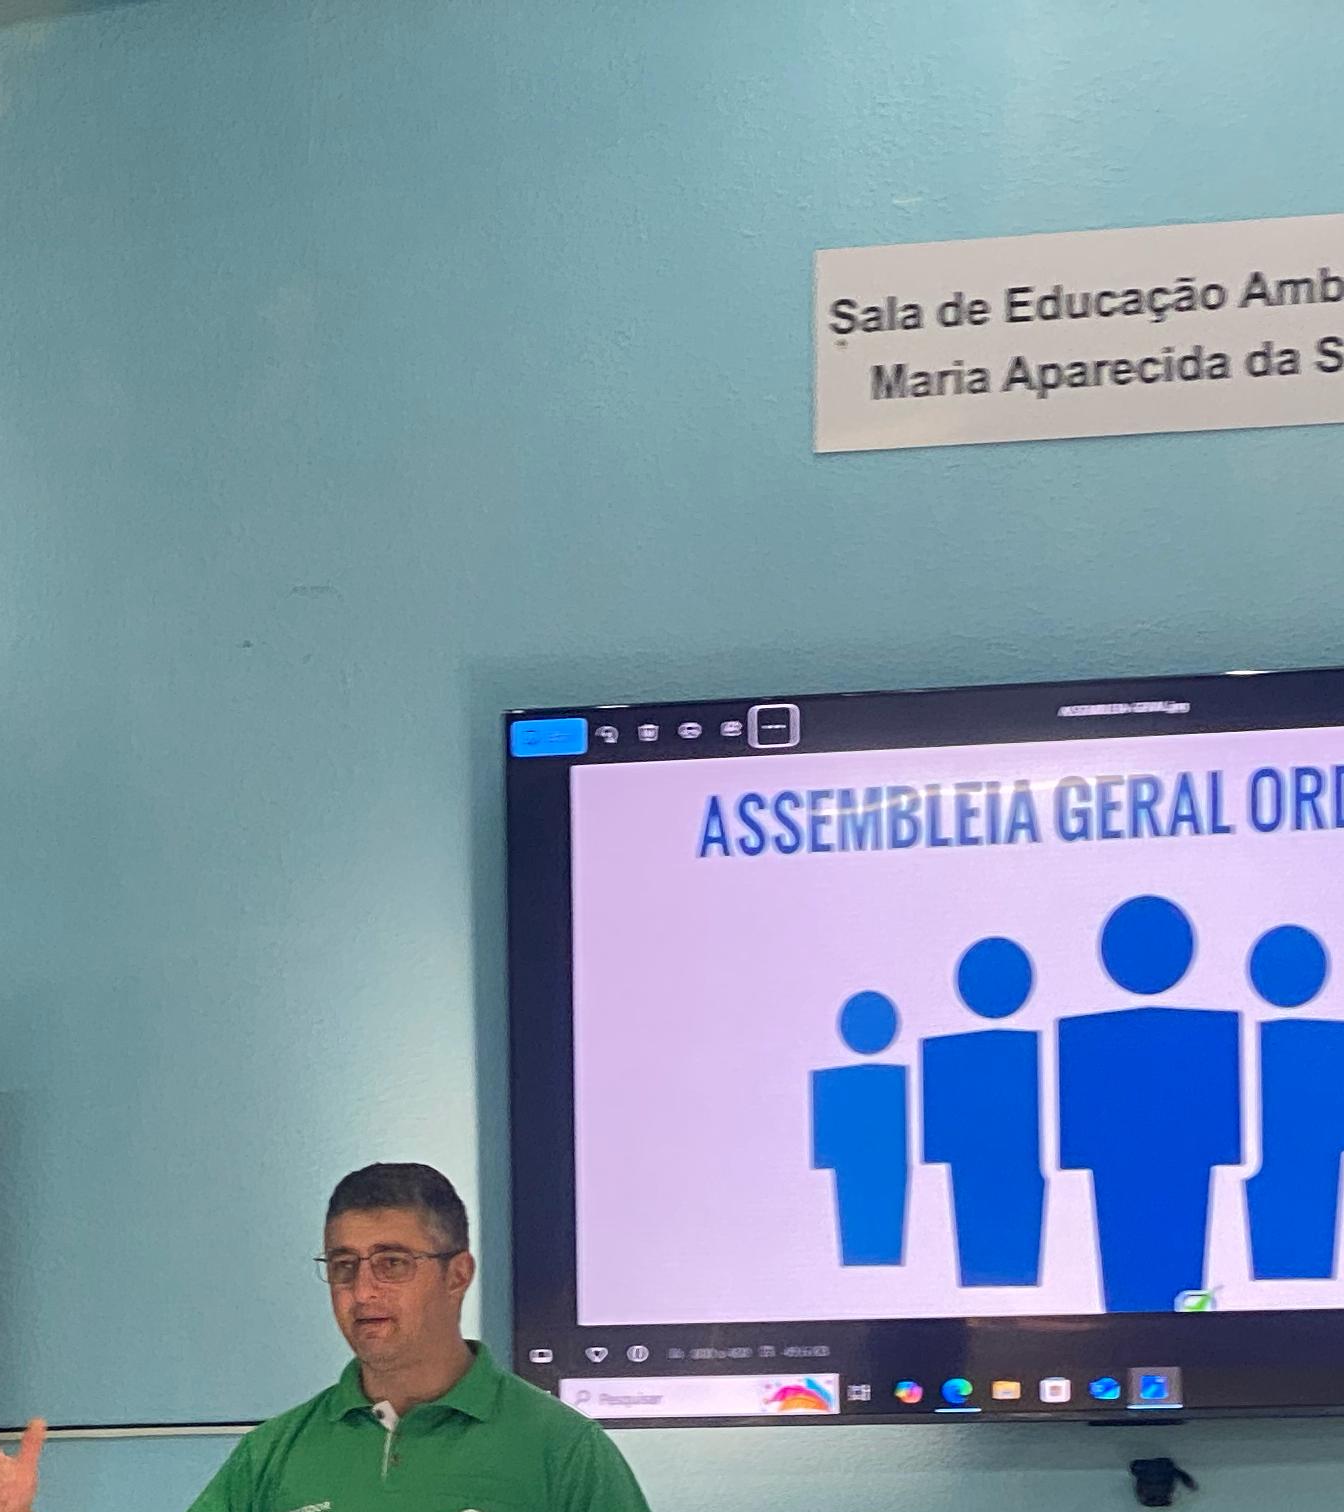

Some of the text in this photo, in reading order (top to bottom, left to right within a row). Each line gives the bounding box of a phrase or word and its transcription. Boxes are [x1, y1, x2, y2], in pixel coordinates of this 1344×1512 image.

[828, 297, 924, 335] Sala
[936, 292, 991, 327] de
[1004, 277, 1226, 323] Educação
[870, 360, 992, 400] Maria
[1001, 346, 1232, 398] Aparecida
[1246, 342, 1300, 378] da
[698, 780, 1040, 857] ASSEMBLEIA
[1056, 769, 1236, 842] GERAL
